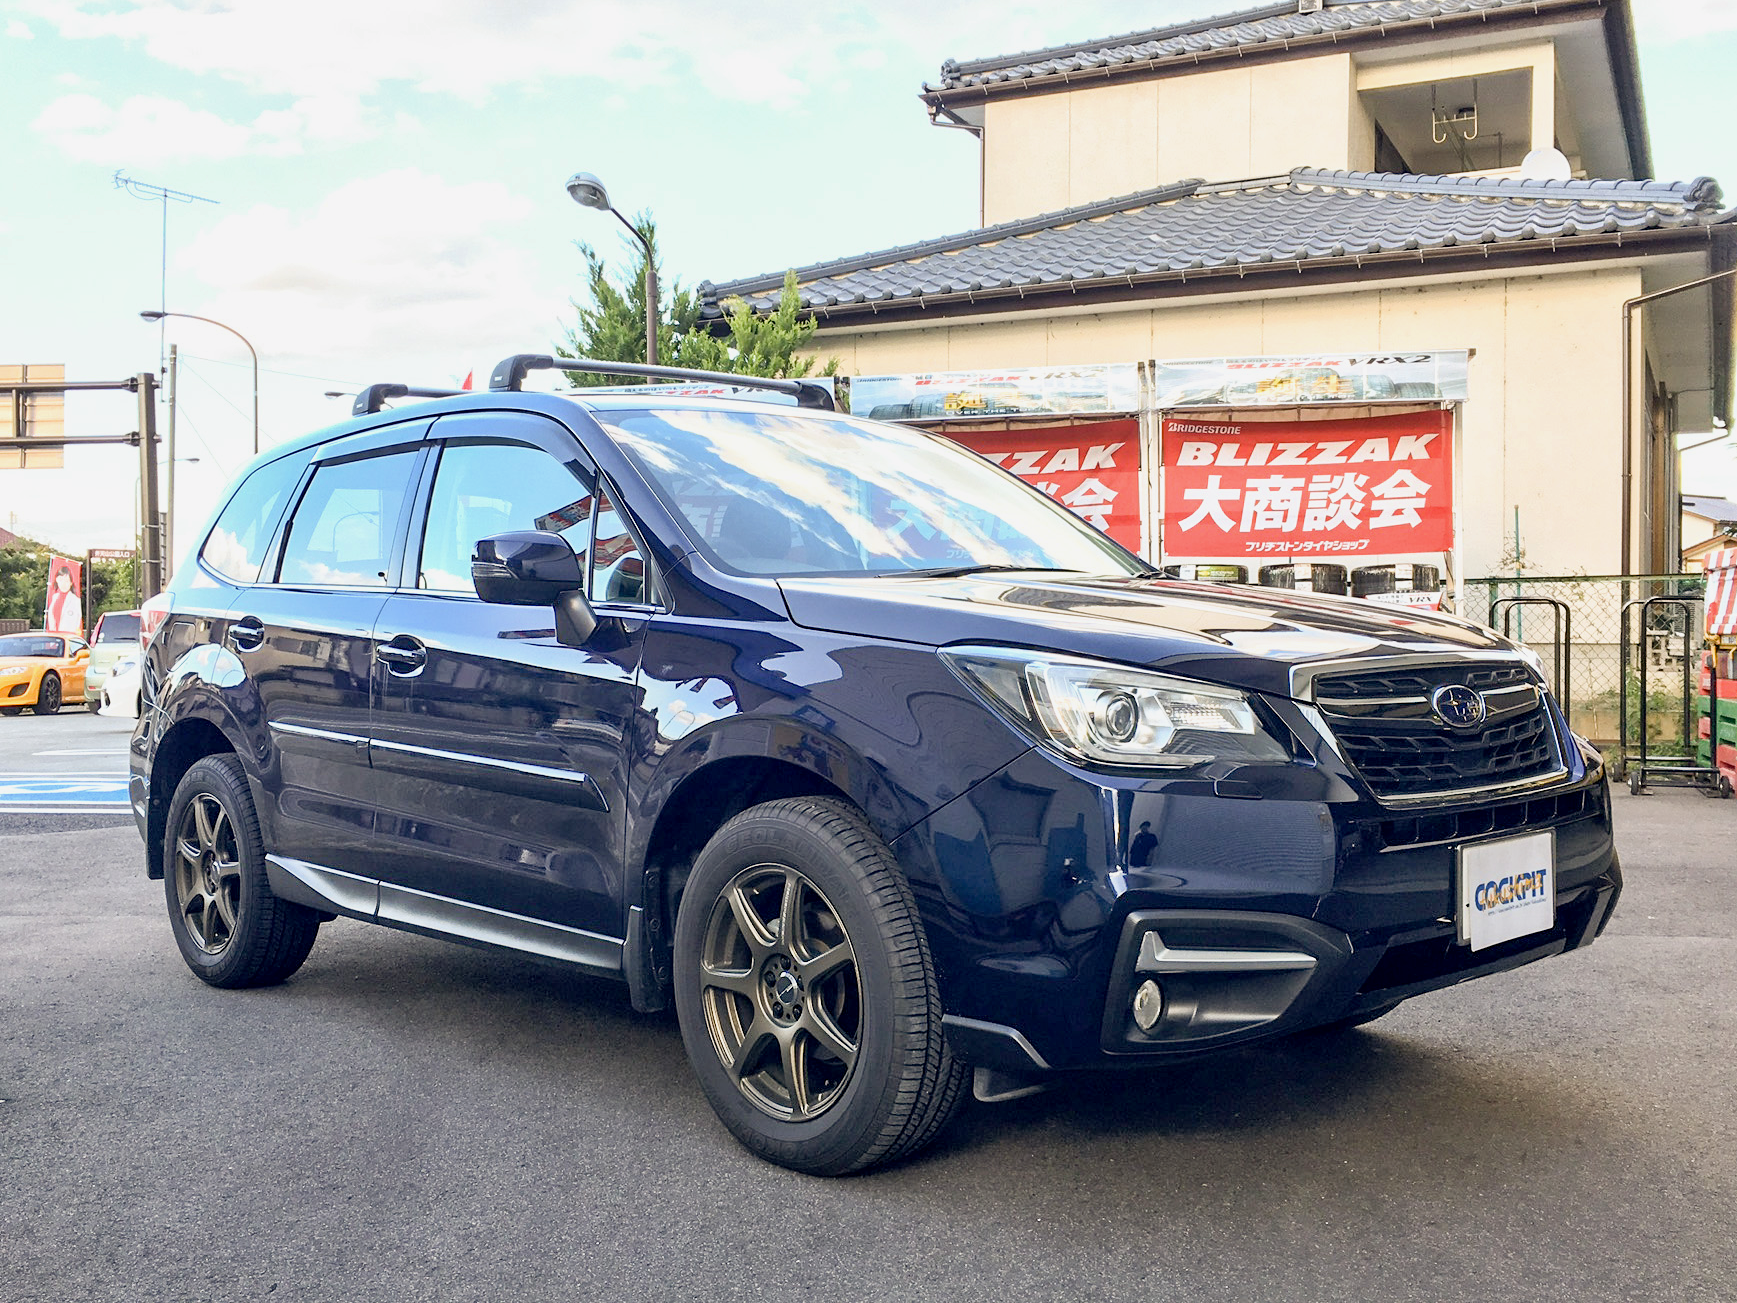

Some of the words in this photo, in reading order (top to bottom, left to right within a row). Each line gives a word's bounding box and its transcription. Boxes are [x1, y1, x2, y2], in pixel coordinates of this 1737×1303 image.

[1349, 354, 1432, 367] VRX2
[1168, 422, 1242, 435] BRIDGESTONE
[981, 442, 1126, 475] ZZAK
[1176, 433, 1440, 467] BLIZZAK
[1177, 469, 1433, 533] 大商談会
[1474, 868, 1547, 912] COCKPIT
